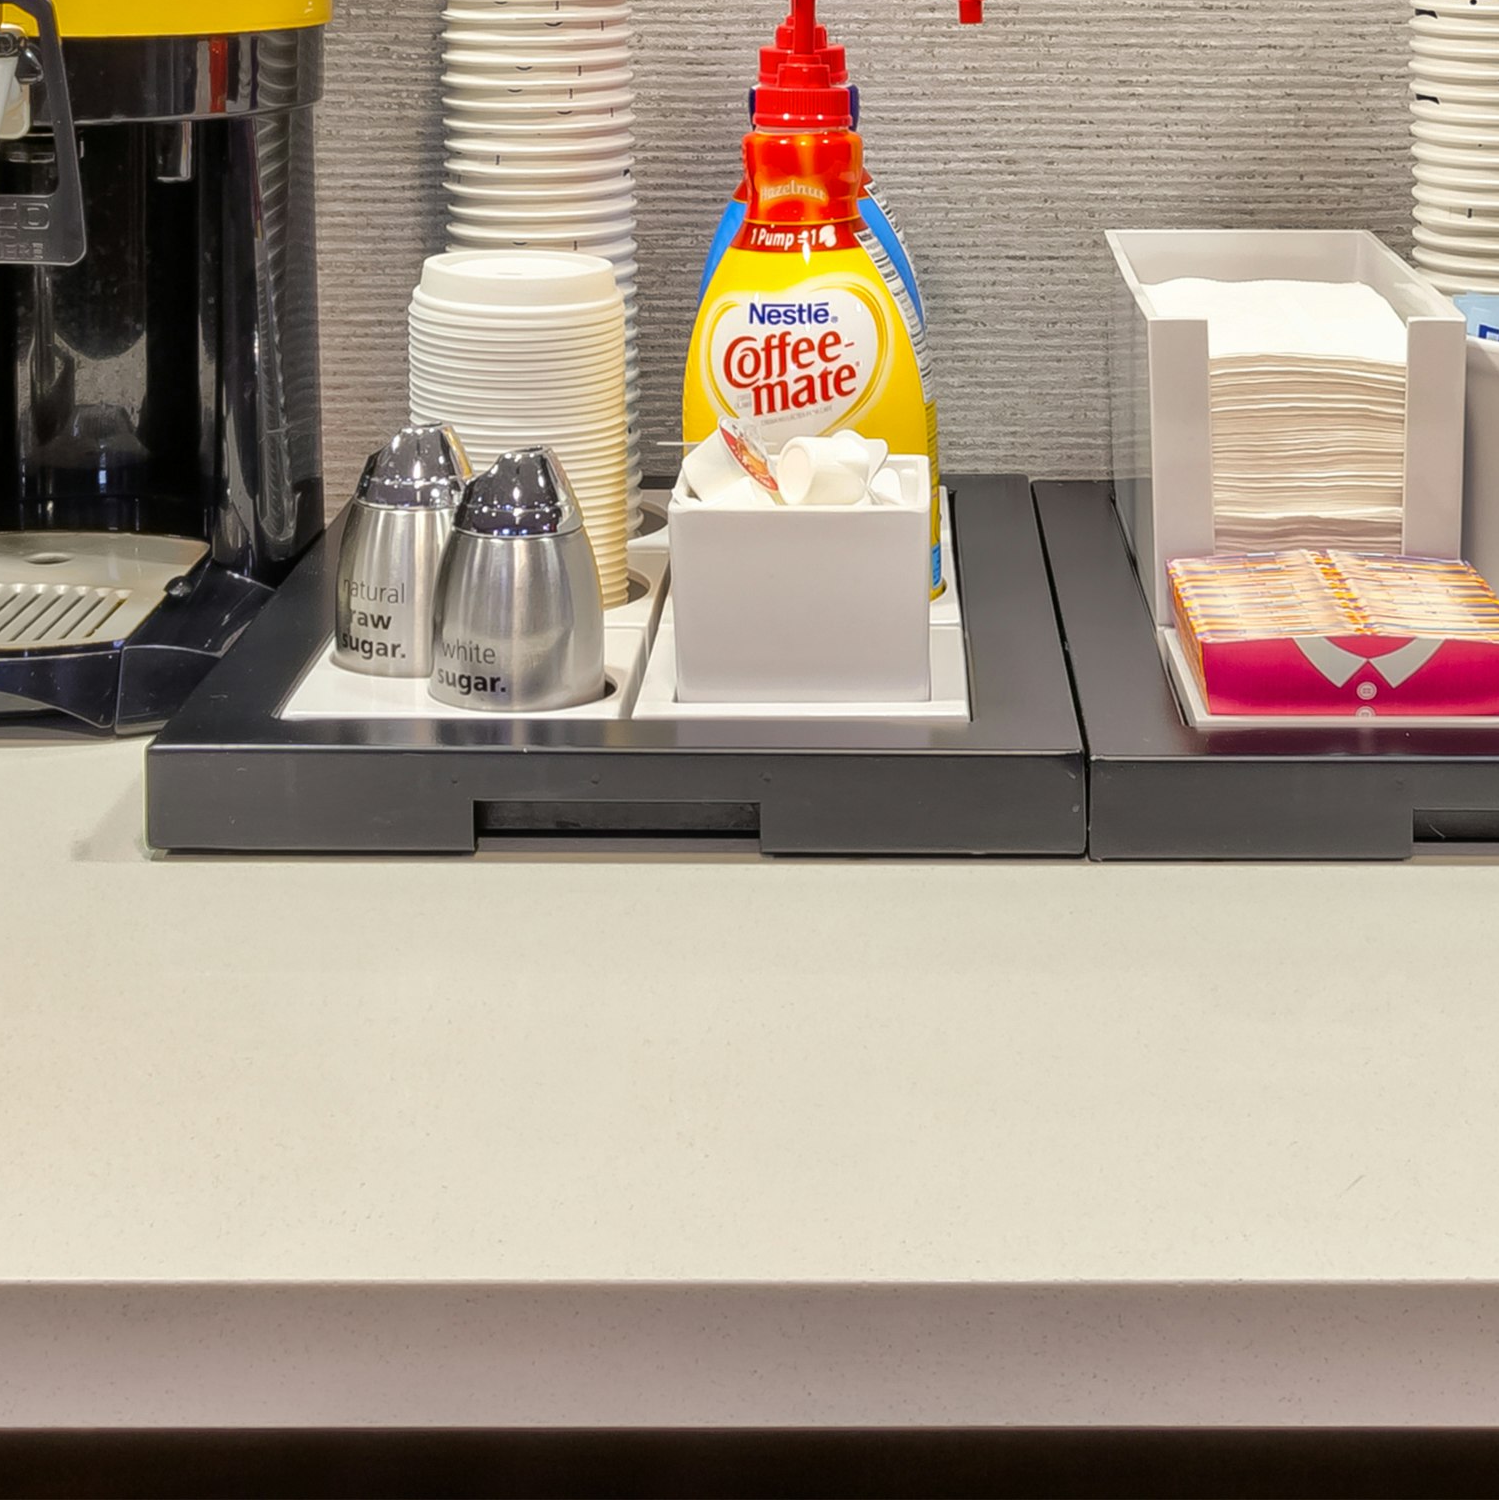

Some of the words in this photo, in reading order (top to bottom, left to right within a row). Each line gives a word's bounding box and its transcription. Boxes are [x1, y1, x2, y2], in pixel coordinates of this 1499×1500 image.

[757, 227, 795, 252] Pump
[751, 362, 857, 417] mate
[342, 575, 406, 604] natural
[348, 608, 393, 631] raw
[341, 635, 407, 660] sugar.
[441, 638, 497, 665] white
[437, 669, 507, 696] sugar.
